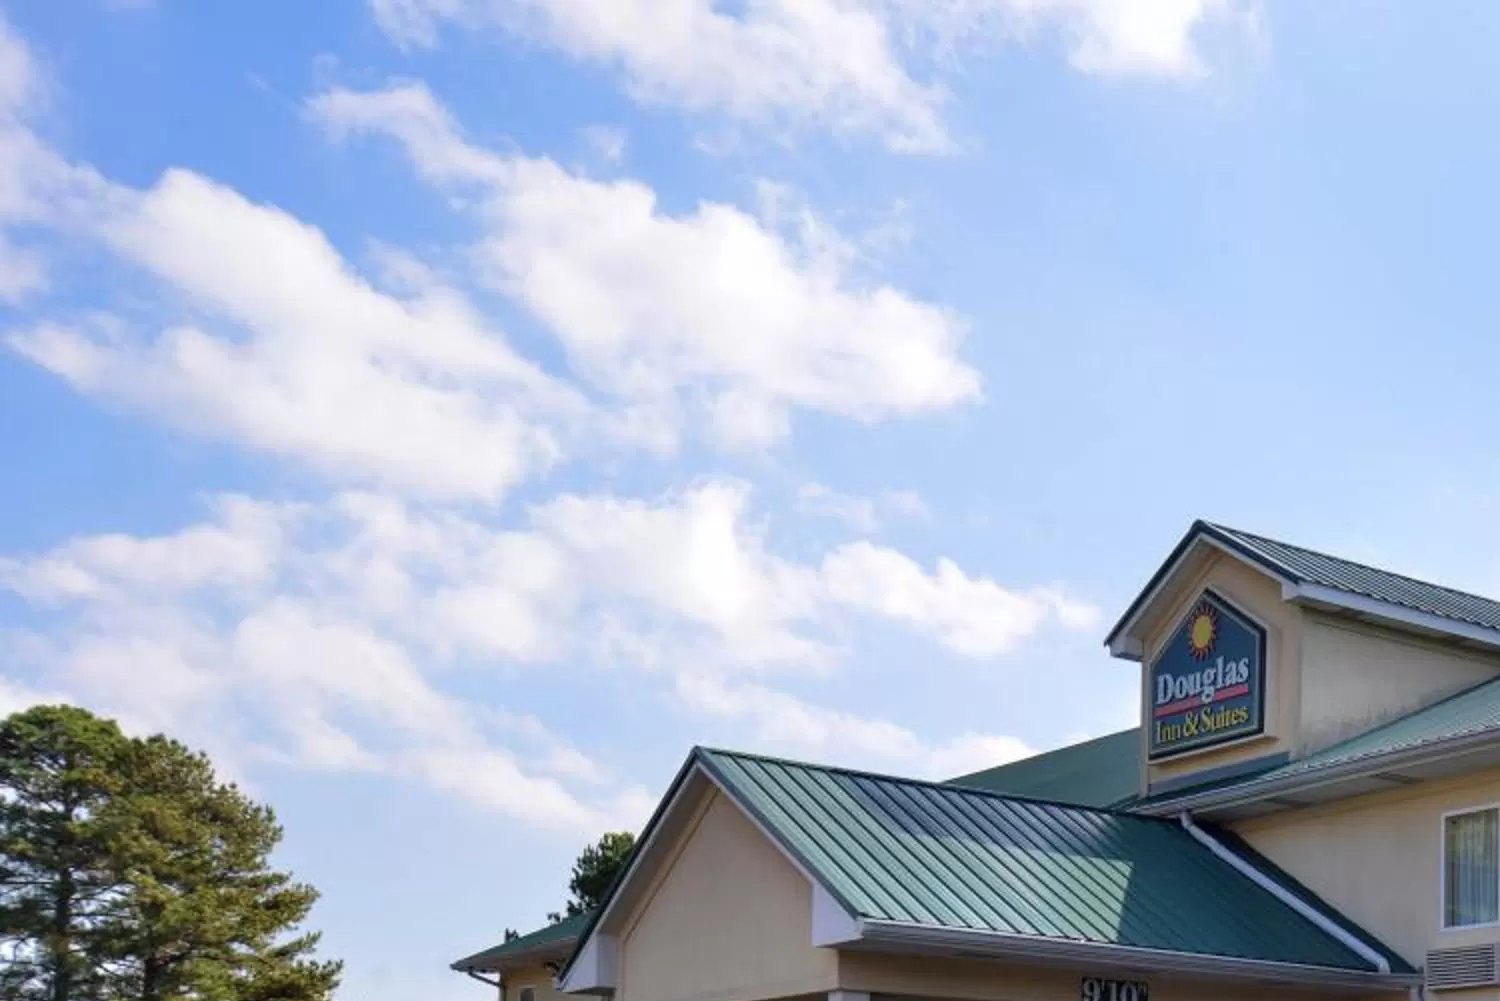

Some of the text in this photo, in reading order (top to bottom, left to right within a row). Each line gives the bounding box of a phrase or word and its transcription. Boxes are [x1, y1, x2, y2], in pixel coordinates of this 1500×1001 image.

[1155, 656, 1249, 704] Douglas
[1156, 705, 1249, 744] Inn & Suites
